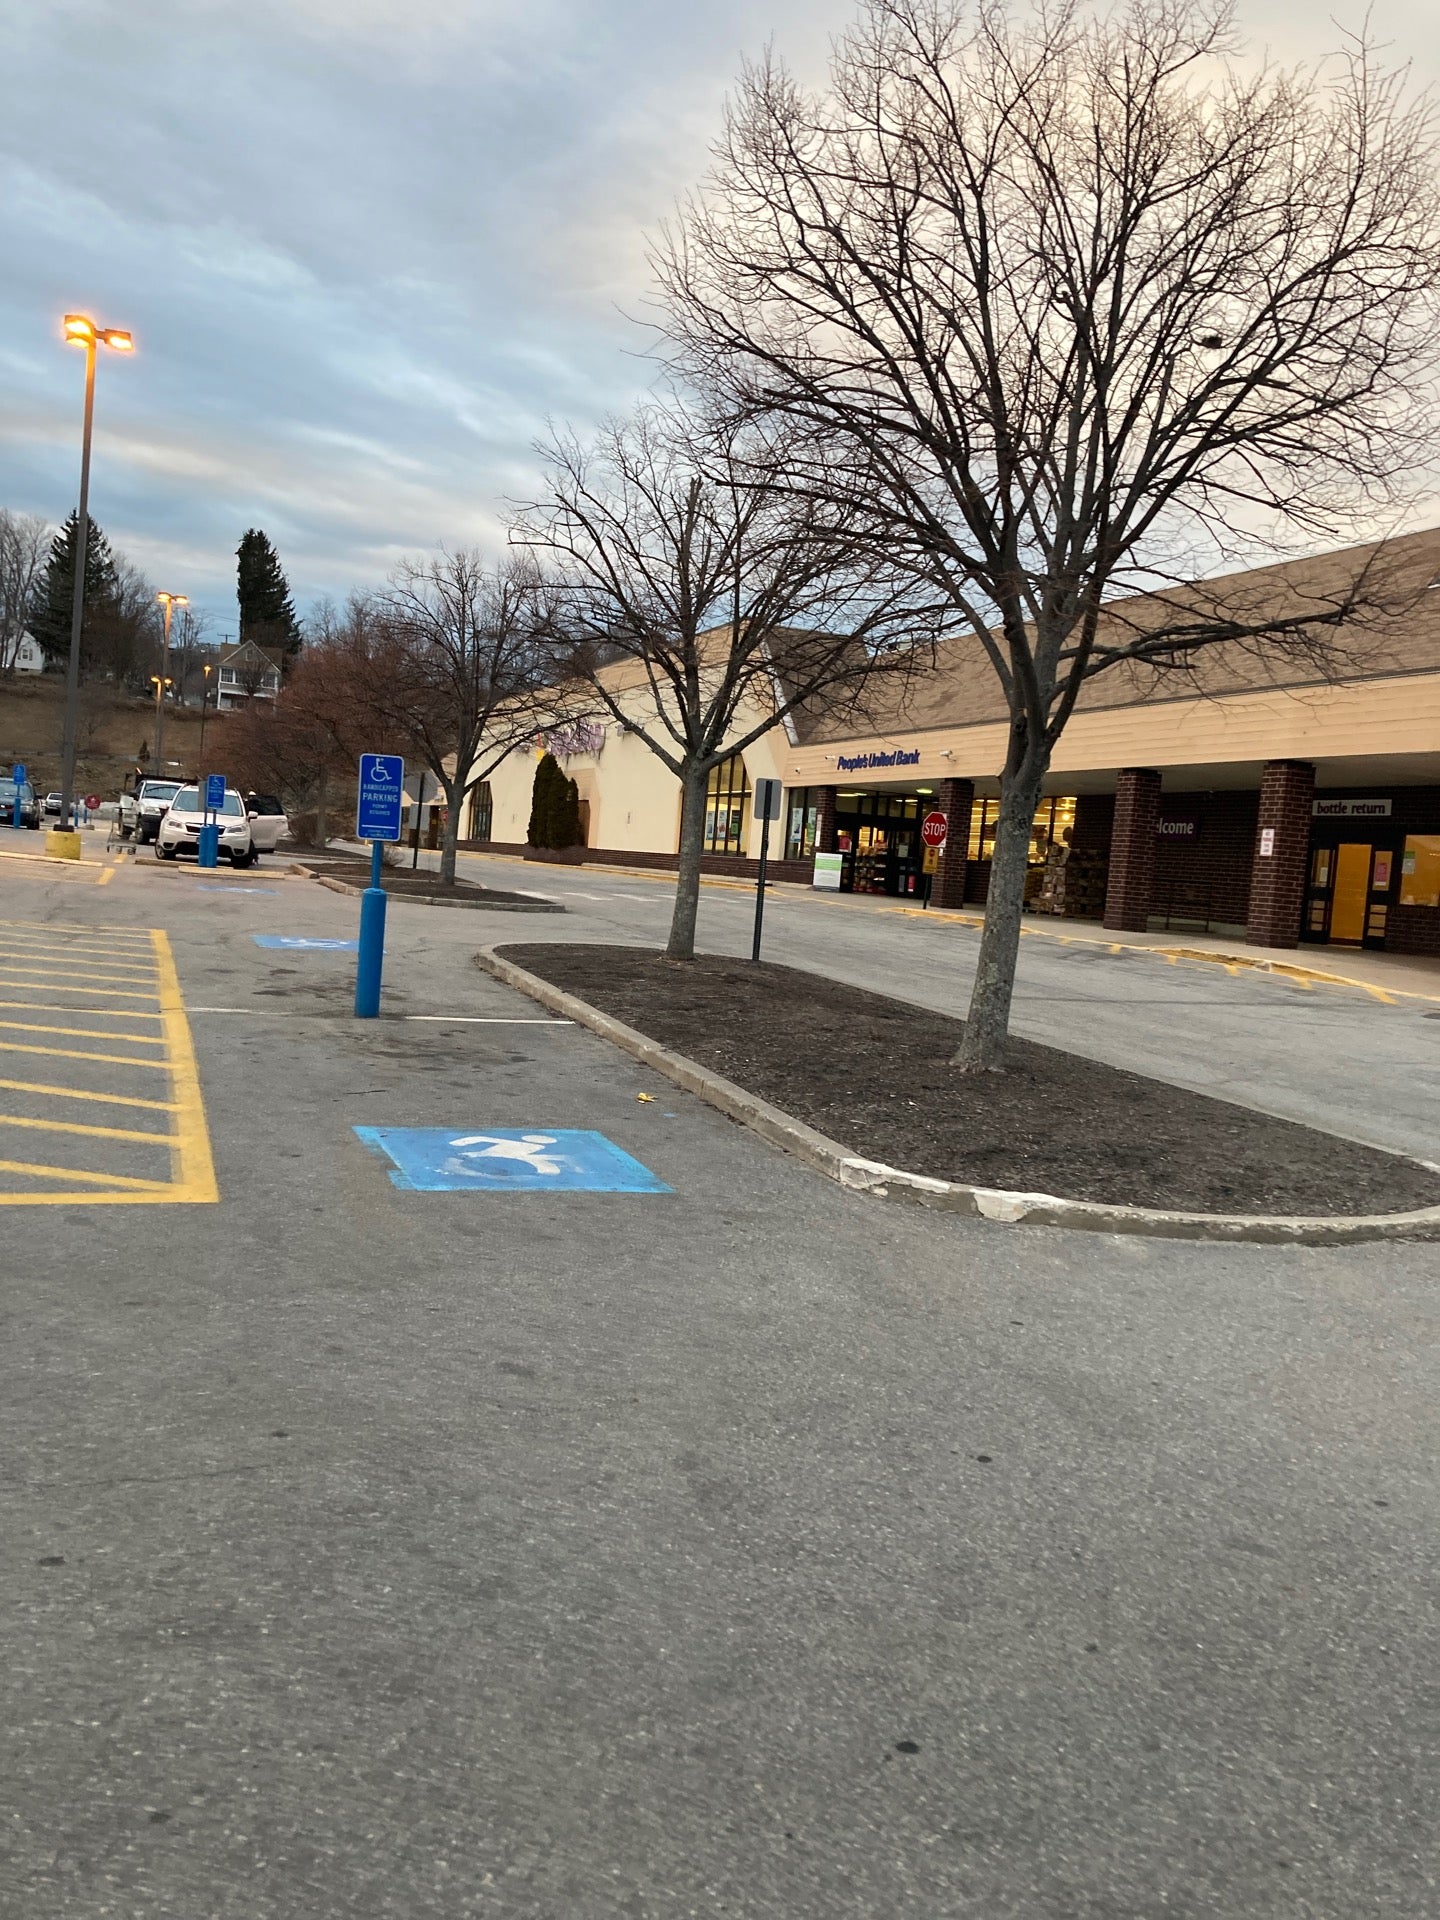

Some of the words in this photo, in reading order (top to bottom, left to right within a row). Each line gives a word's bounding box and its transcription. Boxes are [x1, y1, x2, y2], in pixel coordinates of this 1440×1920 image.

[837, 754, 869, 772] People's
[868, 751, 897, 768] United
[895, 749, 920, 766] Bank
[362, 793, 398, 802] PARKING
[1317, 801, 1348, 814] bottle
[1351, 803, 1386, 814] return
[924, 822, 946, 836] STOP
[1156, 817, 1194, 834] lcome
